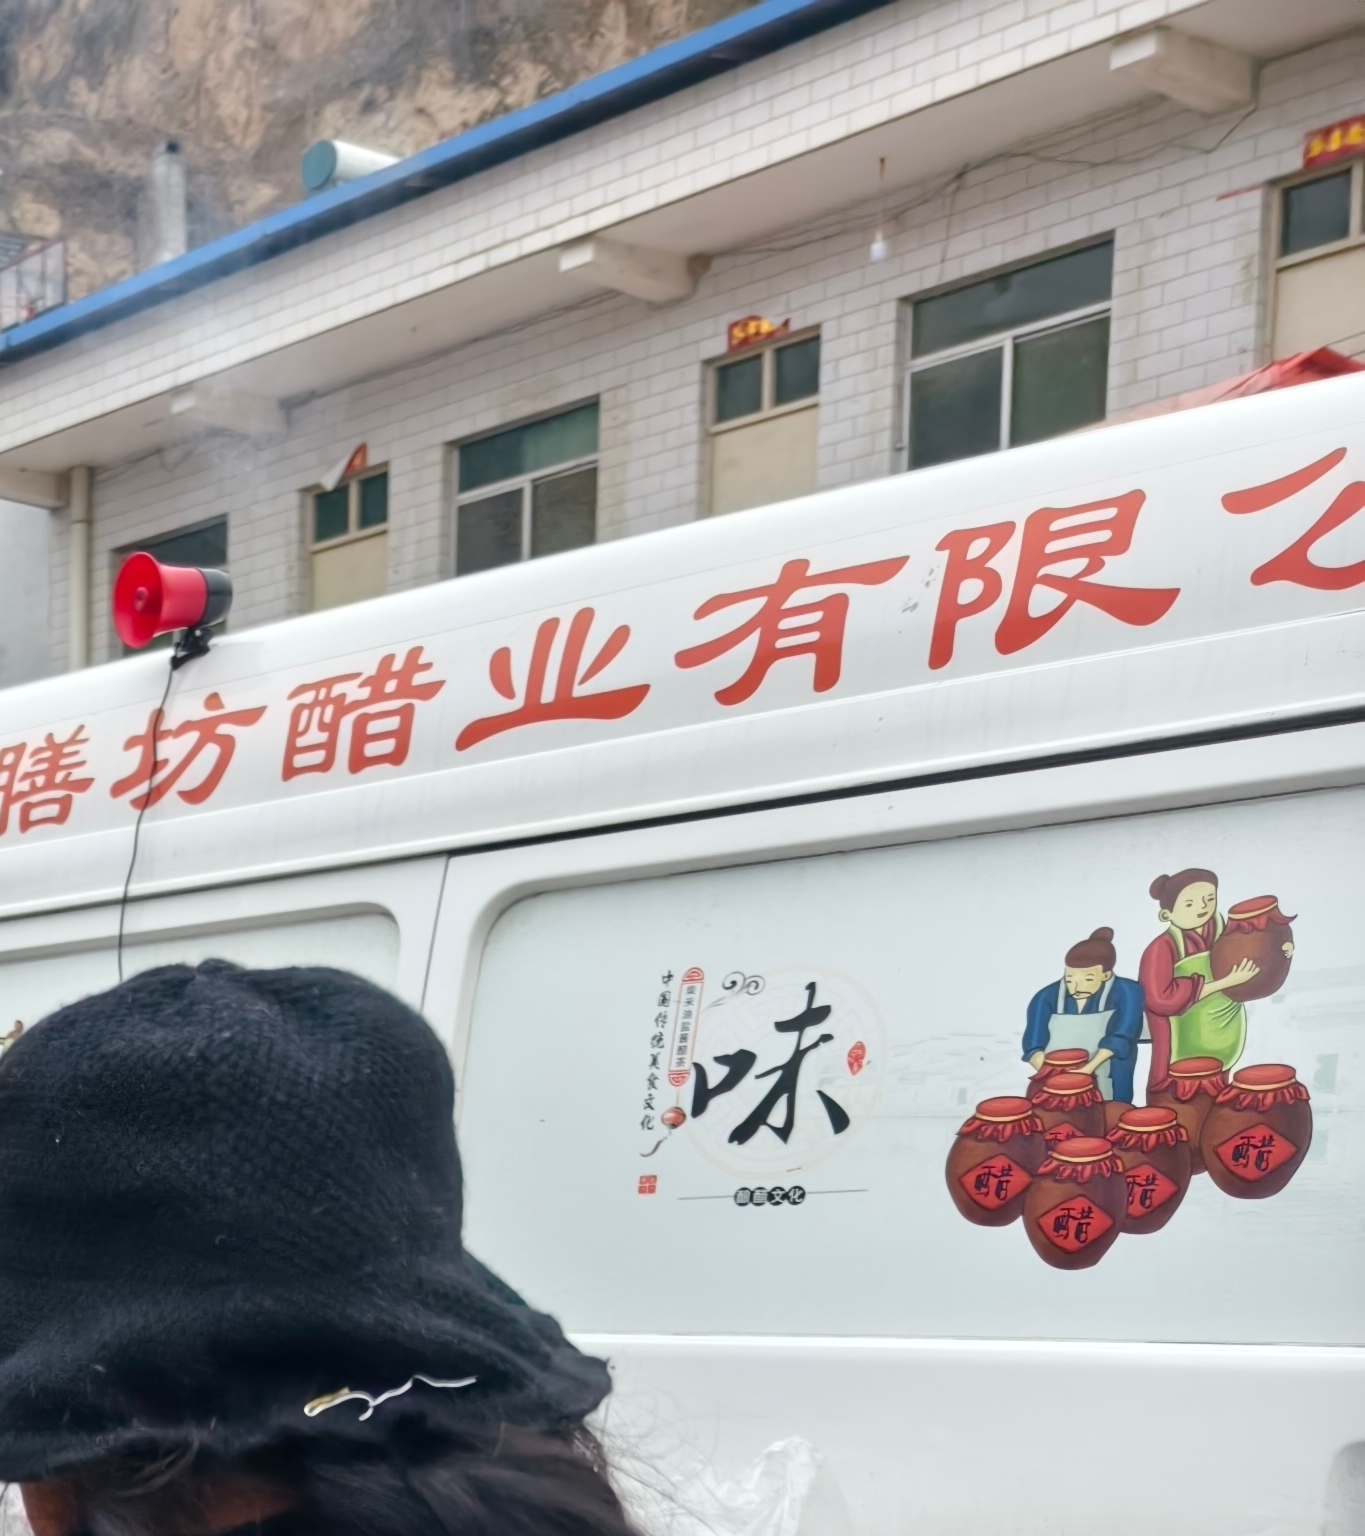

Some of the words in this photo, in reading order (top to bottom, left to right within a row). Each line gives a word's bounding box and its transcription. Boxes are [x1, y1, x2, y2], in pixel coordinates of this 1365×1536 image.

[692, 981, 851, 1146] 味
[1231, 1135, 1277, 1173] 醋
[975, 1164, 1014, 1202] 醋
[1052, 1207, 1095, 1244] 醋
